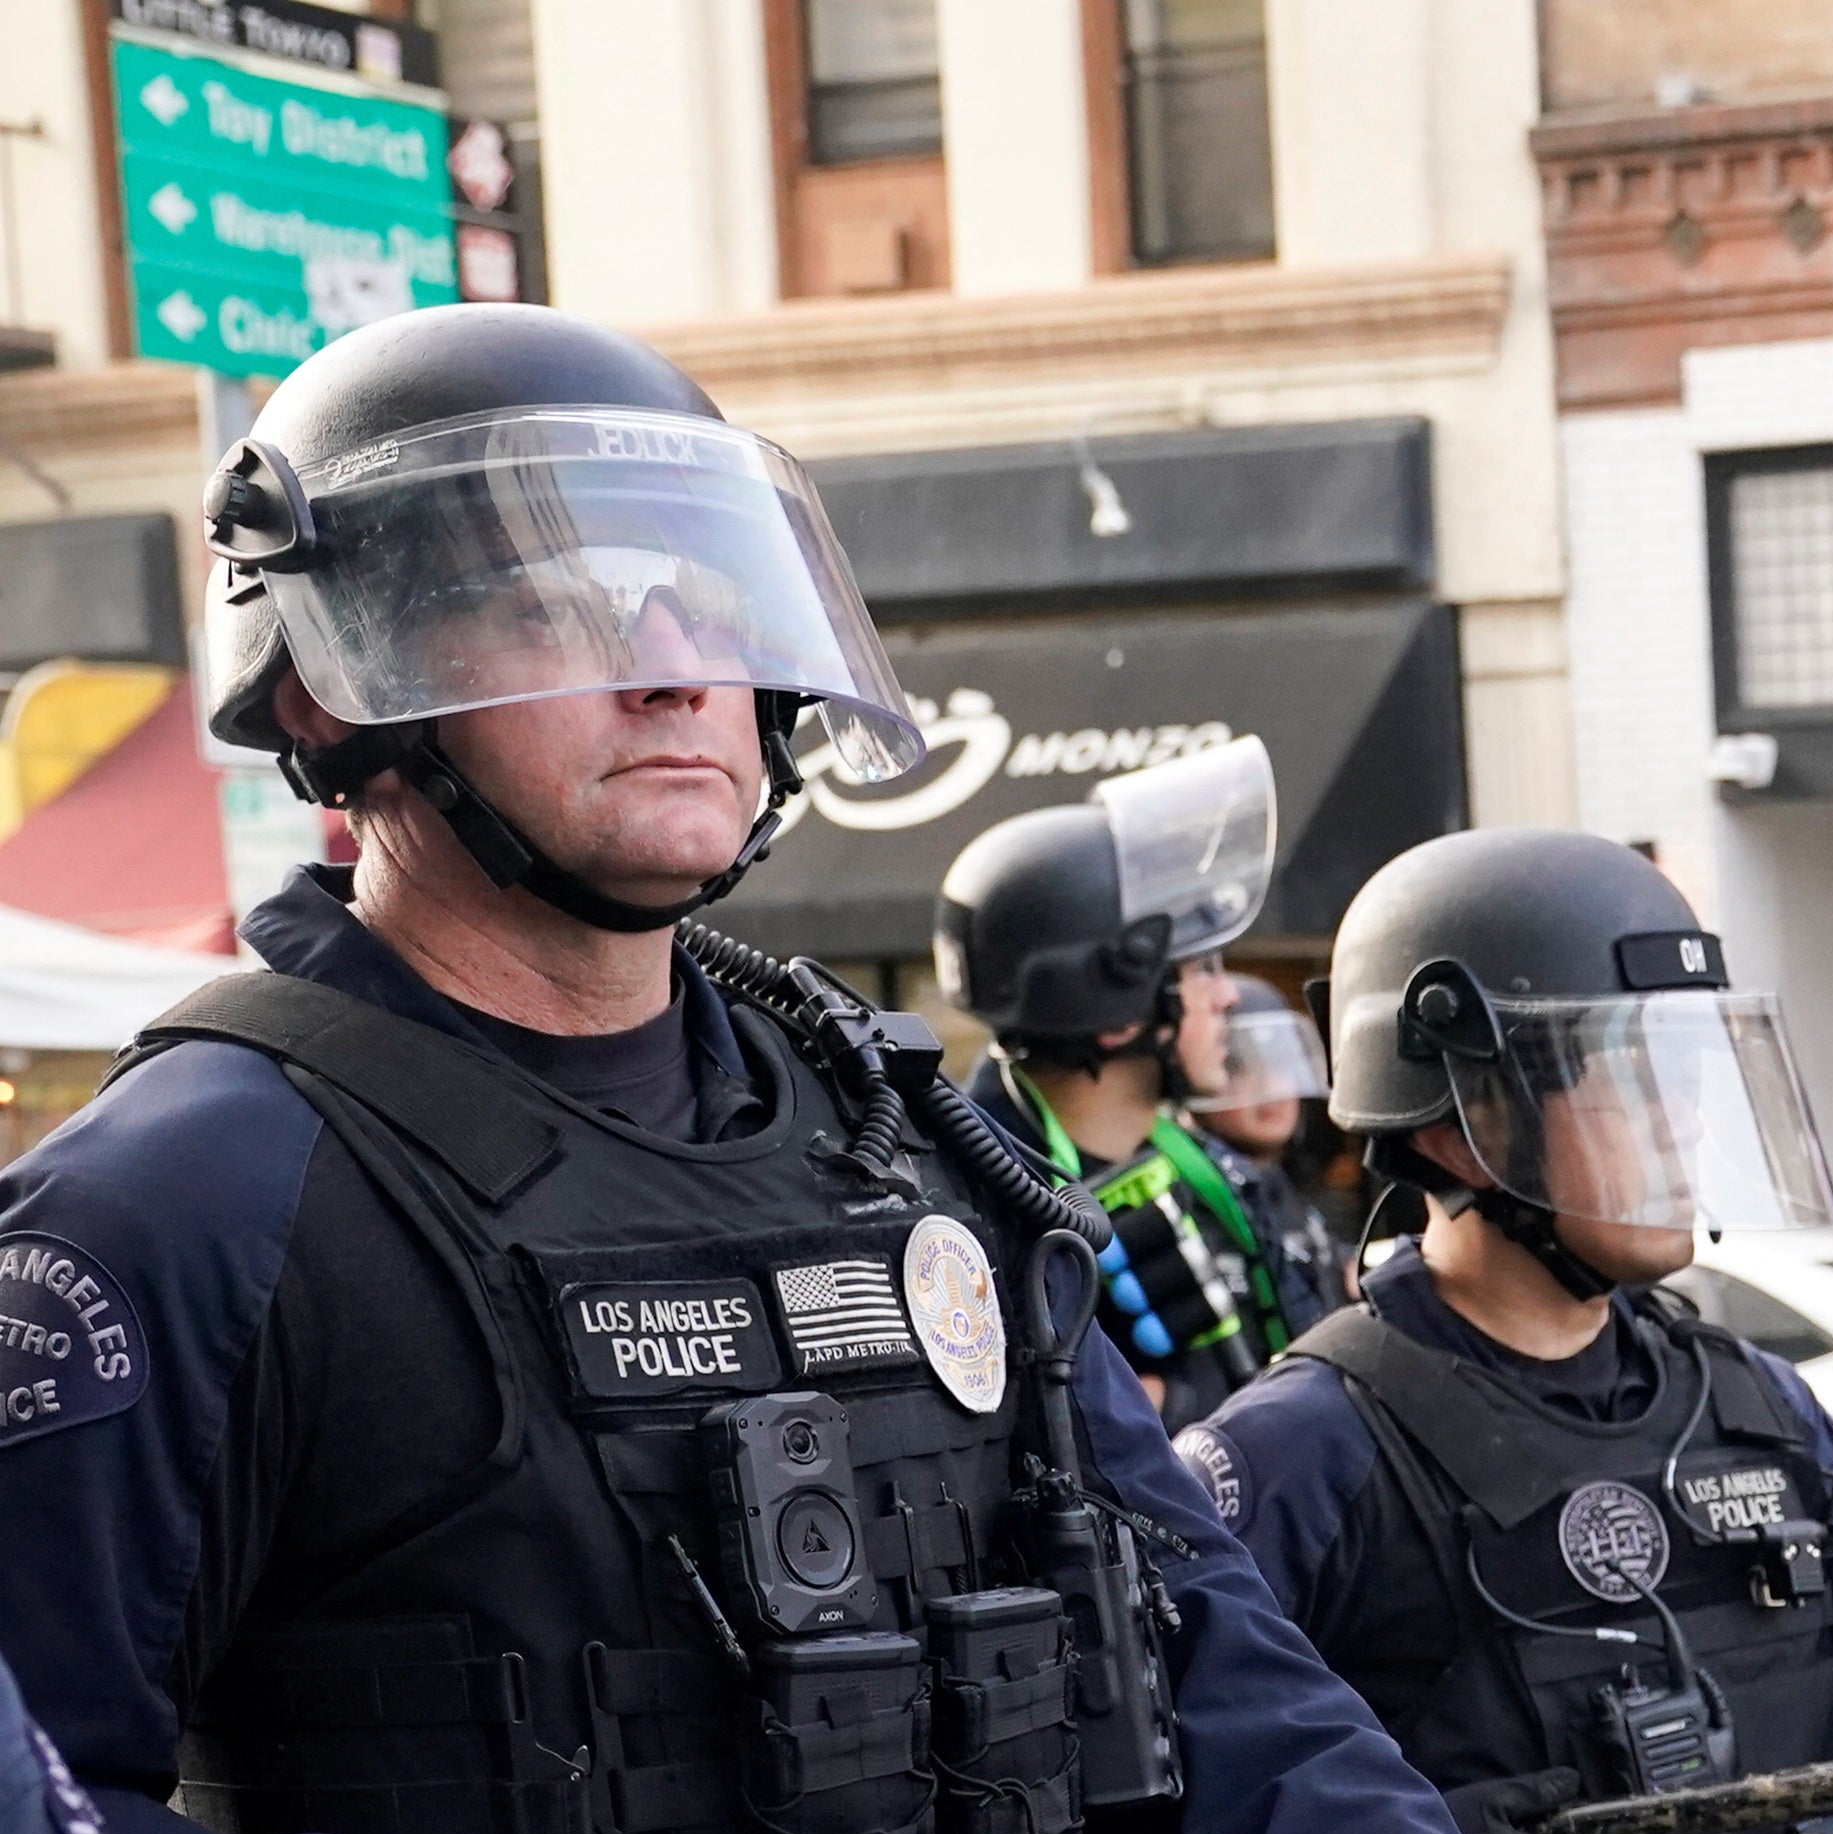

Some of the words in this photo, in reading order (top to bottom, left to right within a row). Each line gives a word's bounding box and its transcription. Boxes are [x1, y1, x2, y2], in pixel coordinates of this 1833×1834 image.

[203, 80, 272, 156] Toy
[281, 99, 428, 181] District
[1005, 721, 1233, 778] MONZO
[0, 1248, 131, 1382] ANGELES
[580, 1300, 634, 1333] LOS
[640, 1297, 752, 1333] ANGELES
[0, 1314, 72, 1361] TRO
[612, 1335, 741, 1378] POLICE
[804, 1347, 843, 1363] LAPD
[0, 1379, 60, 1427] ICE
[1684, 1475, 1721, 1504] LOS
[1707, 1493, 1786, 1533] POLICE
[818, 1610, 844, 1622] AXON
